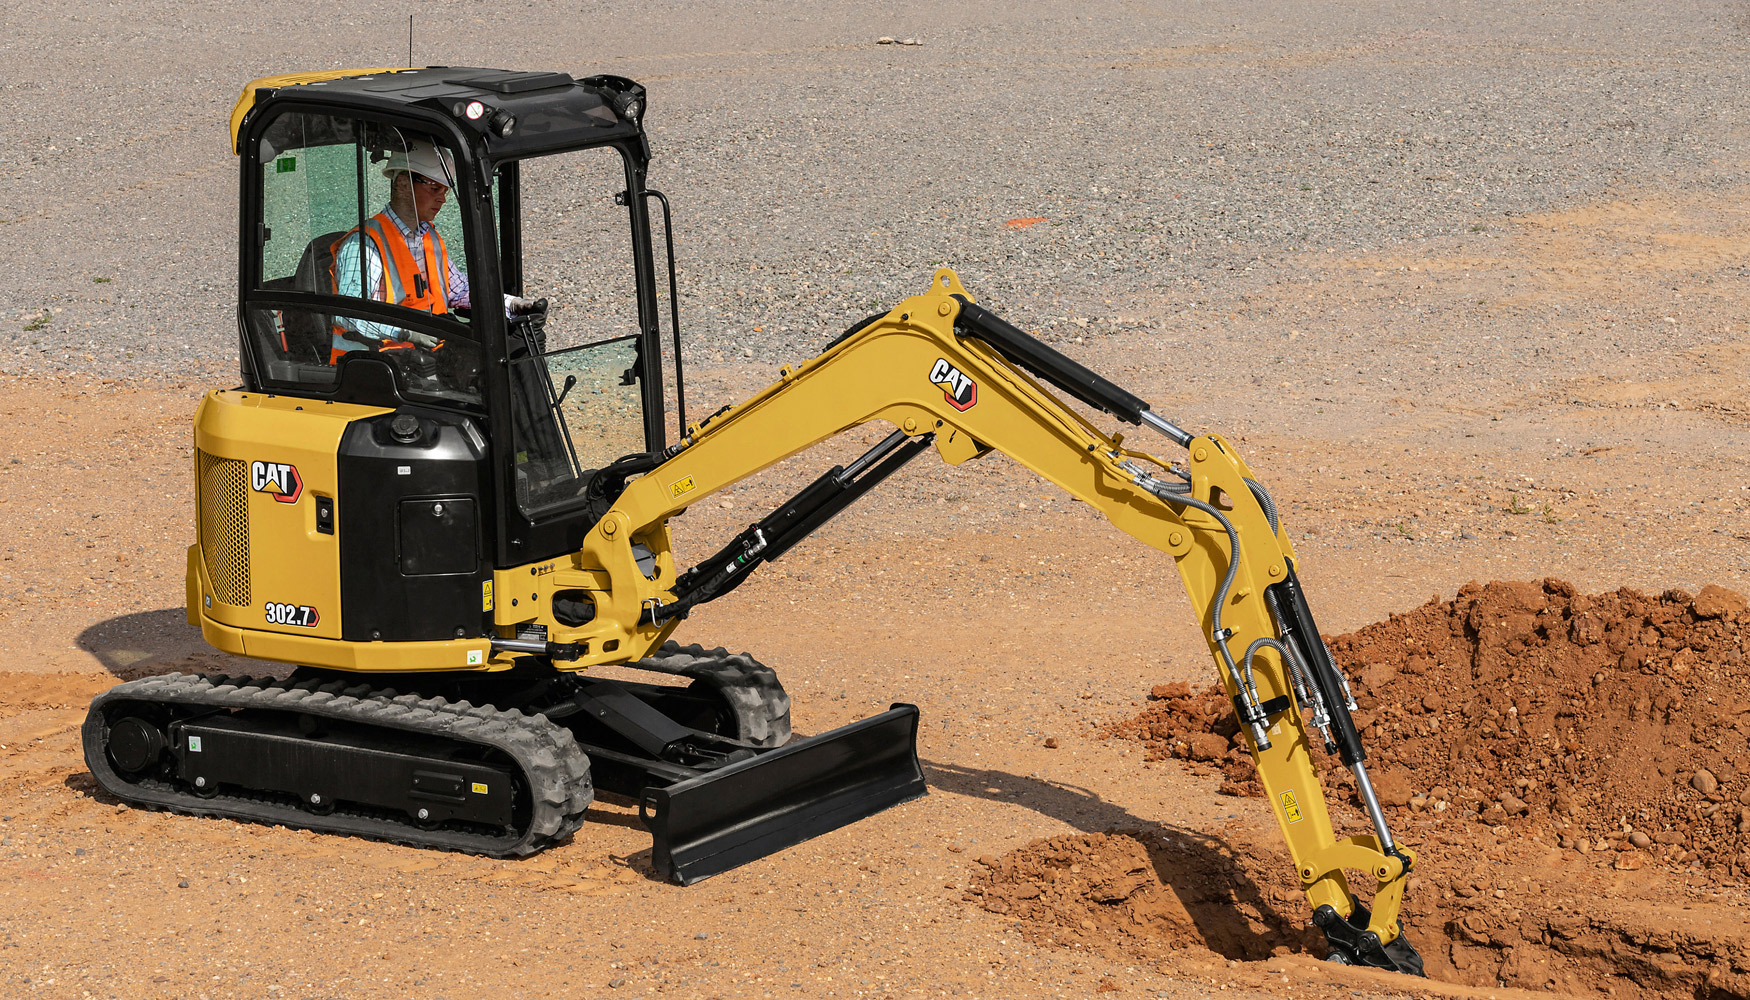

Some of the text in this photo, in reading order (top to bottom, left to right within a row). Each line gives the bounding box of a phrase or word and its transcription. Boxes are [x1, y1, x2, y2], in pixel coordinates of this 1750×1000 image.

[930, 358, 973, 401] CAT
[252, 461, 291, 494] CAT
[266, 602, 310, 626] 302.7
